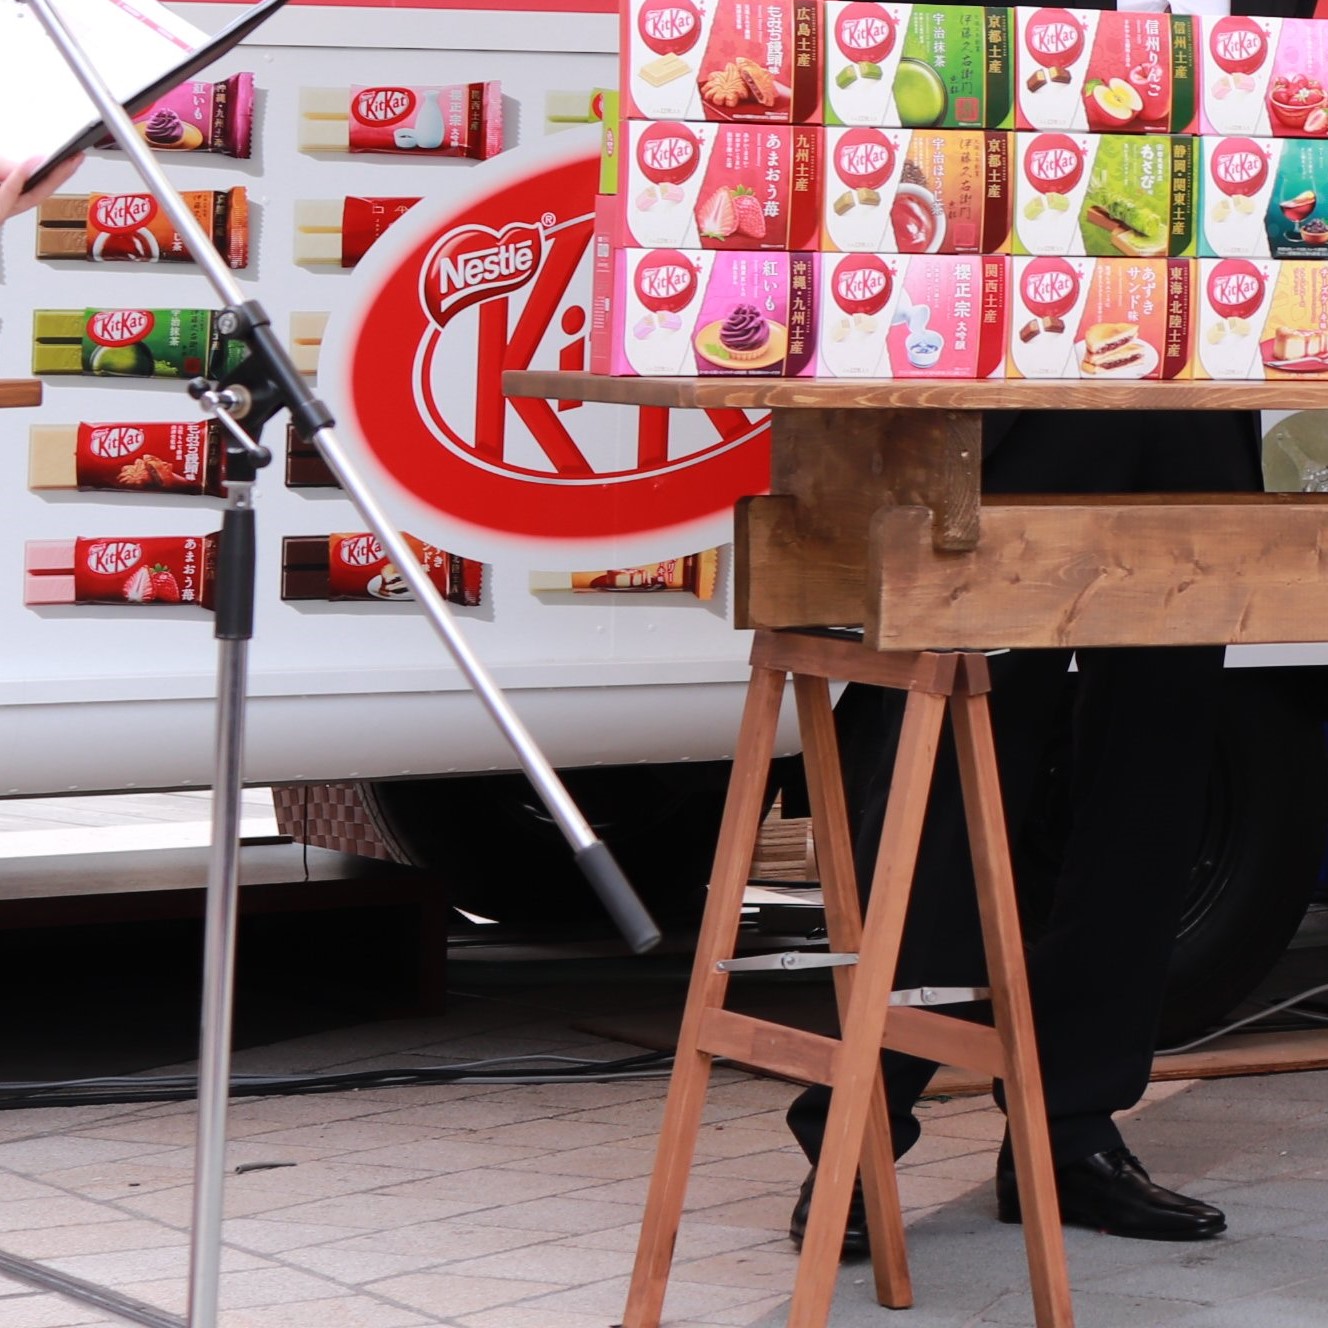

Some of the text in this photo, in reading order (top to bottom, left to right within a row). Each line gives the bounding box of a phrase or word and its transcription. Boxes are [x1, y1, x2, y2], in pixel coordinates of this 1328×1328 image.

[652, 9, 691, 38] KitKat
[796, 7, 811, 68] 広島土産
[849, 18, 886, 48] KitKat
[1038, 23, 1075, 53] KitKat
[932, 13, 946, 69] 宇治抹茶
[987, 15, 1002, 74] 京都土産
[1145, 19, 1162, 97] 信州りんご
[1173, 21, 1188, 79] 信州土産
[1222, 30, 1258, 60] KitKat
[191, 83, 207, 120] 紅いも
[366, 90, 408, 120] KitKat
[651, 138, 690, 169] KitKat
[794, 134, 810, 192] 九州土産
[848, 145, 886, 174] KitKat
[987, 139, 1001, 199] 京都土産
[1037, 149, 1074, 179] KitKat
[1223, 153, 1259, 182] KitKat
[763, 133, 781, 218] あまおう苺
[931, 138, 945, 216] 宇治ほうじ茶
[103, 196, 149, 227] KitKat
[649, 265, 687, 297] KitKat
[762, 260, 779, 312] 紅いも
[844, 270, 883, 300] KitKat
[983, 263, 999, 324] 関西土産
[1032, 272, 1070, 302] KitKat
[1127, 266, 1141, 321] サンド味
[1142, 267, 1157, 315] あずき
[1219, 274, 1256, 304] KitKat
[101, 310, 147, 340] KitKat
[789, 260, 807, 356] 沖縄・九州土産
[1167, 267, 1184, 358] 東海・北陸土産
[97, 427, 142, 458] KitKat
[95, 542, 138, 573] KitKat
[181, 539, 197, 601] あまおう苺
